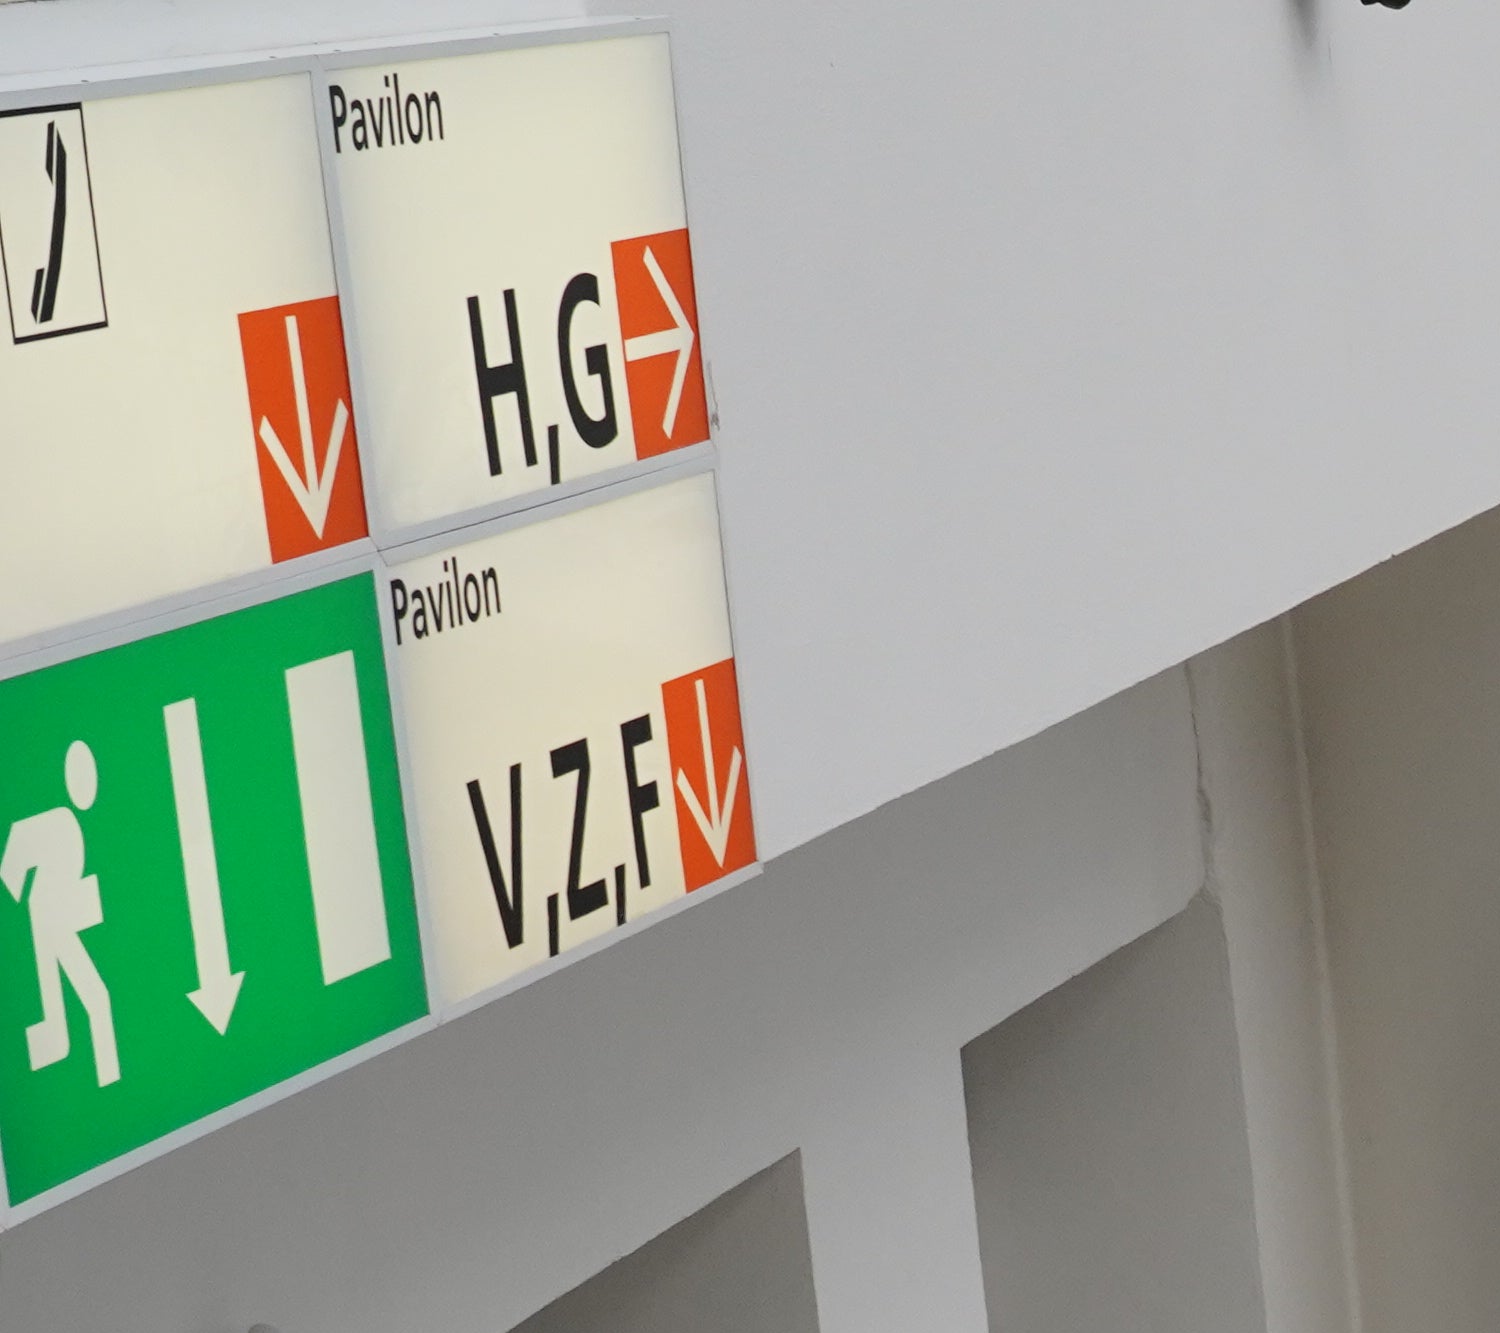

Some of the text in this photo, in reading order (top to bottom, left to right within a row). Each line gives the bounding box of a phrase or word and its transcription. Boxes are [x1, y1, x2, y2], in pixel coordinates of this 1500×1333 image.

[328, 72, 444, 154] Pavilon
[466, 272, 619, 487] H,G
[389, 556, 502, 647] Pavilon
[466, 713, 660, 959] V,Z,F
